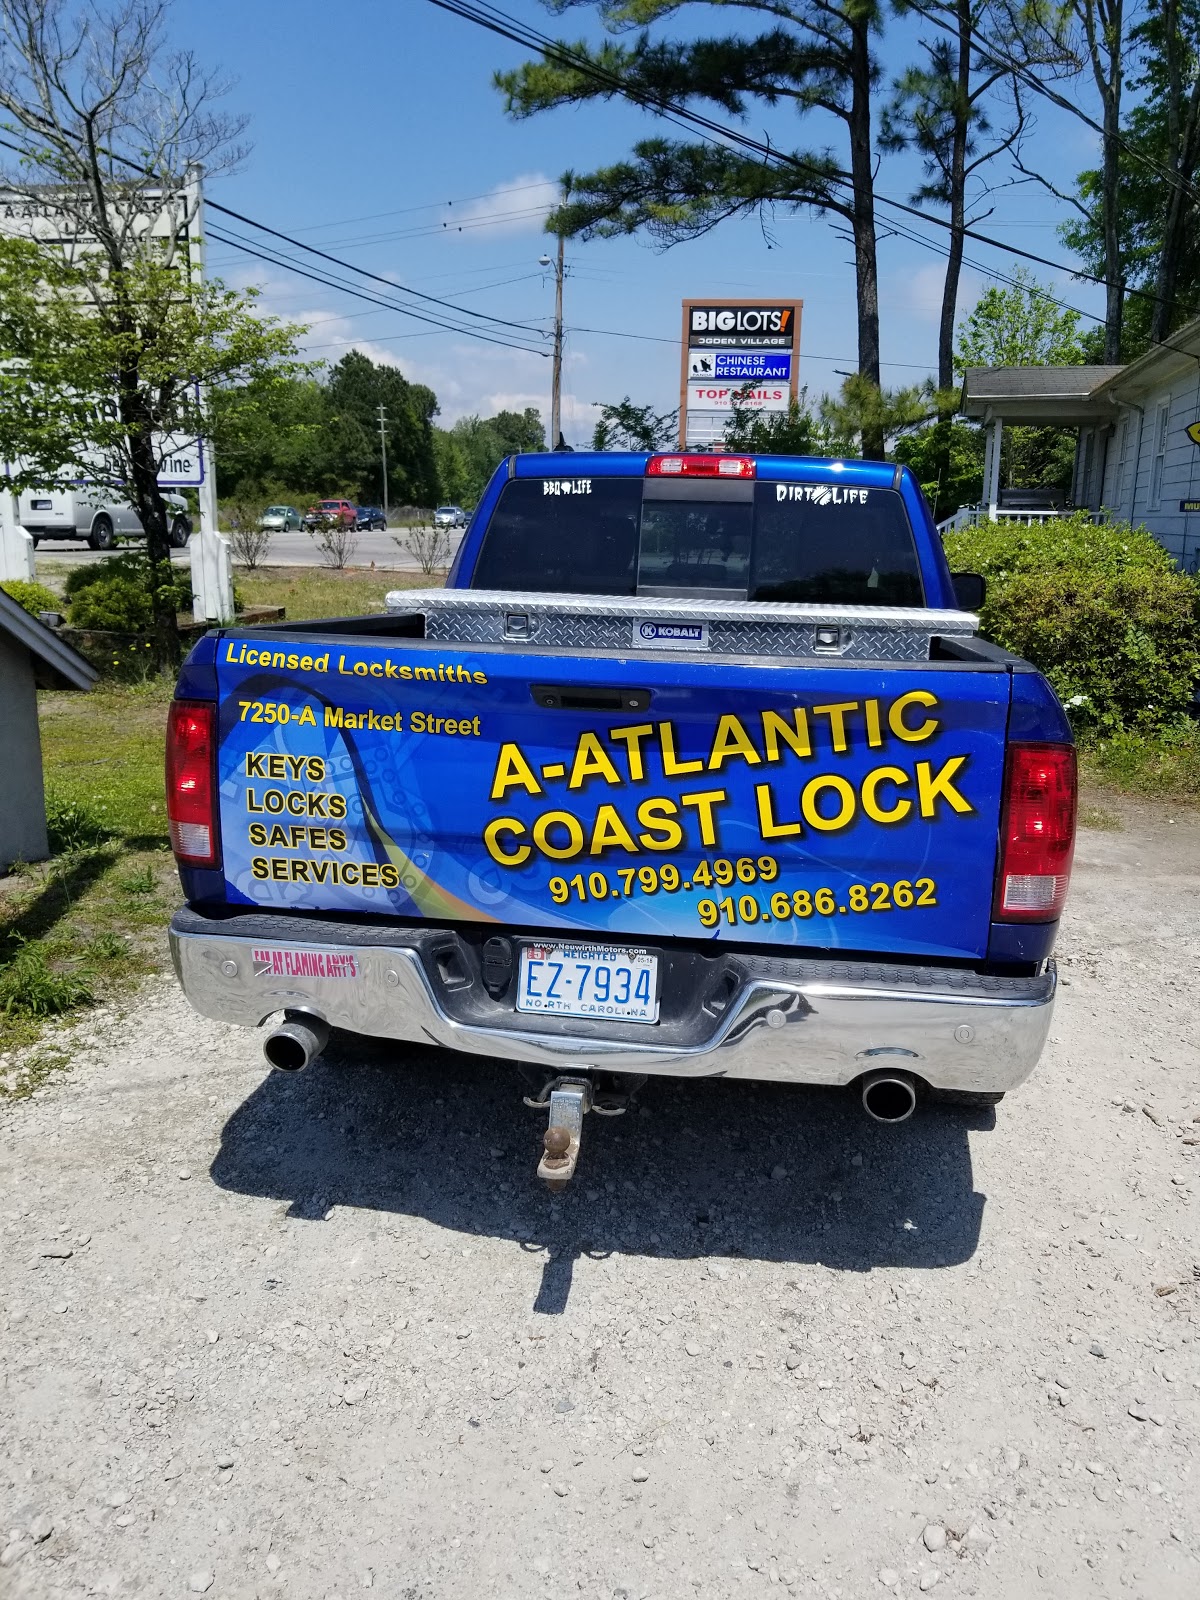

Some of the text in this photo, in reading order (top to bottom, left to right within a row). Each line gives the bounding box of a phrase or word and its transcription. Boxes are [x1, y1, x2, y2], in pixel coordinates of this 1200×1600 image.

[716, 367, 787, 376] RESTAURANT
[717, 356, 765, 365] CHINESE
[696, 390, 728, 399] TOP
[543, 480, 592, 495] BBQ LIFE
[776, 485, 868, 505] DIRT LIFE
[658, 627, 700, 638] KOBALT
[225, 643, 488, 684] Licensed Locksmiths
[238, 701, 481, 736] 7250-A Market Street
[489, 690, 939, 799] A-ATLANTIC
[246, 752, 325, 782] KEYS
[247, 788, 347, 819] LOCKS
[484, 756, 972, 866] COAST LOCK
[249, 823, 347, 851] SAFES
[252, 856, 399, 888] SERVICES
[549, 855, 778, 904] 910.799.4969
[698, 877, 936, 926] 910.686.8262
[533, 942, 647, 955] www.NeuwirthMotors.com
[272, 952, 284, 975] AT
[285, 952, 326, 977] FLAMING
[526, 961, 650, 1005] EZ-7934
[525, 999, 647, 1017] NORTH CAROLINA
